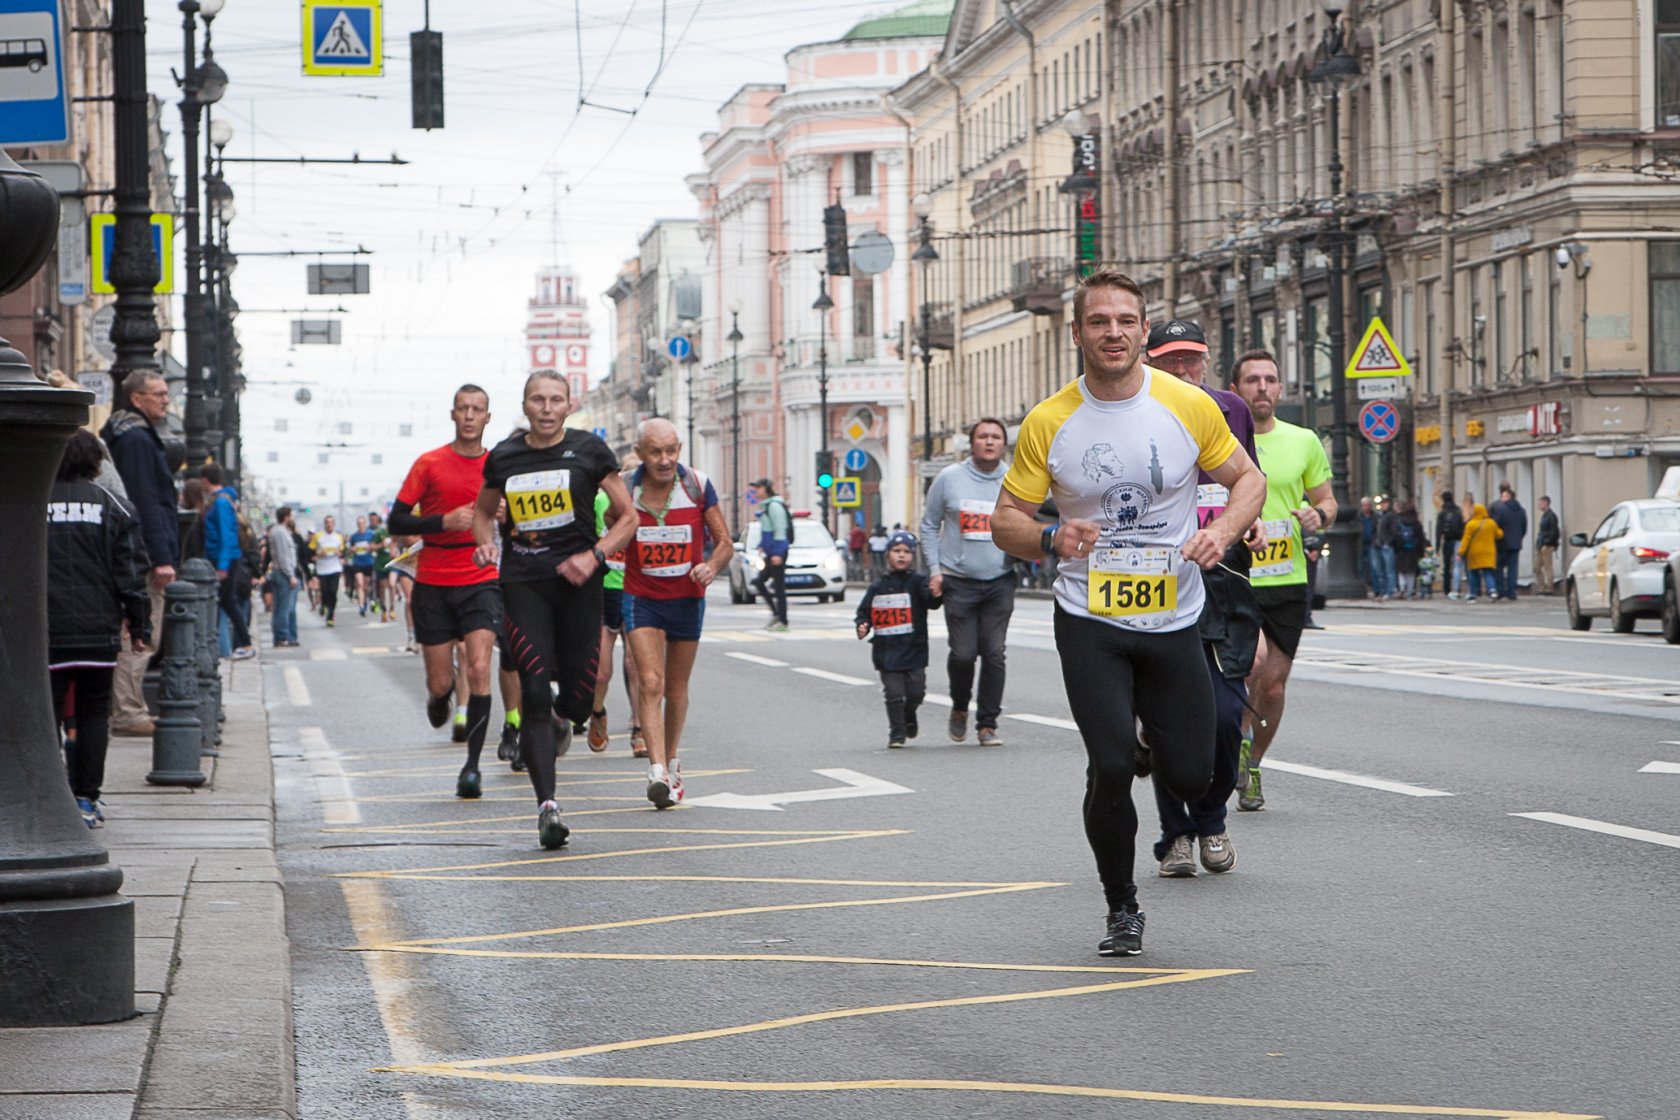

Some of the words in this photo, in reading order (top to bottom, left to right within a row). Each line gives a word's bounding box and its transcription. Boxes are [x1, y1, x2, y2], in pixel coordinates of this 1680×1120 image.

[515, 491, 566, 515] 1184
[963, 513, 992, 530] 221
[642, 543, 687, 565] 2327
[1099, 579, 1166, 608] 1581
[874, 608, 908, 626] 2215
